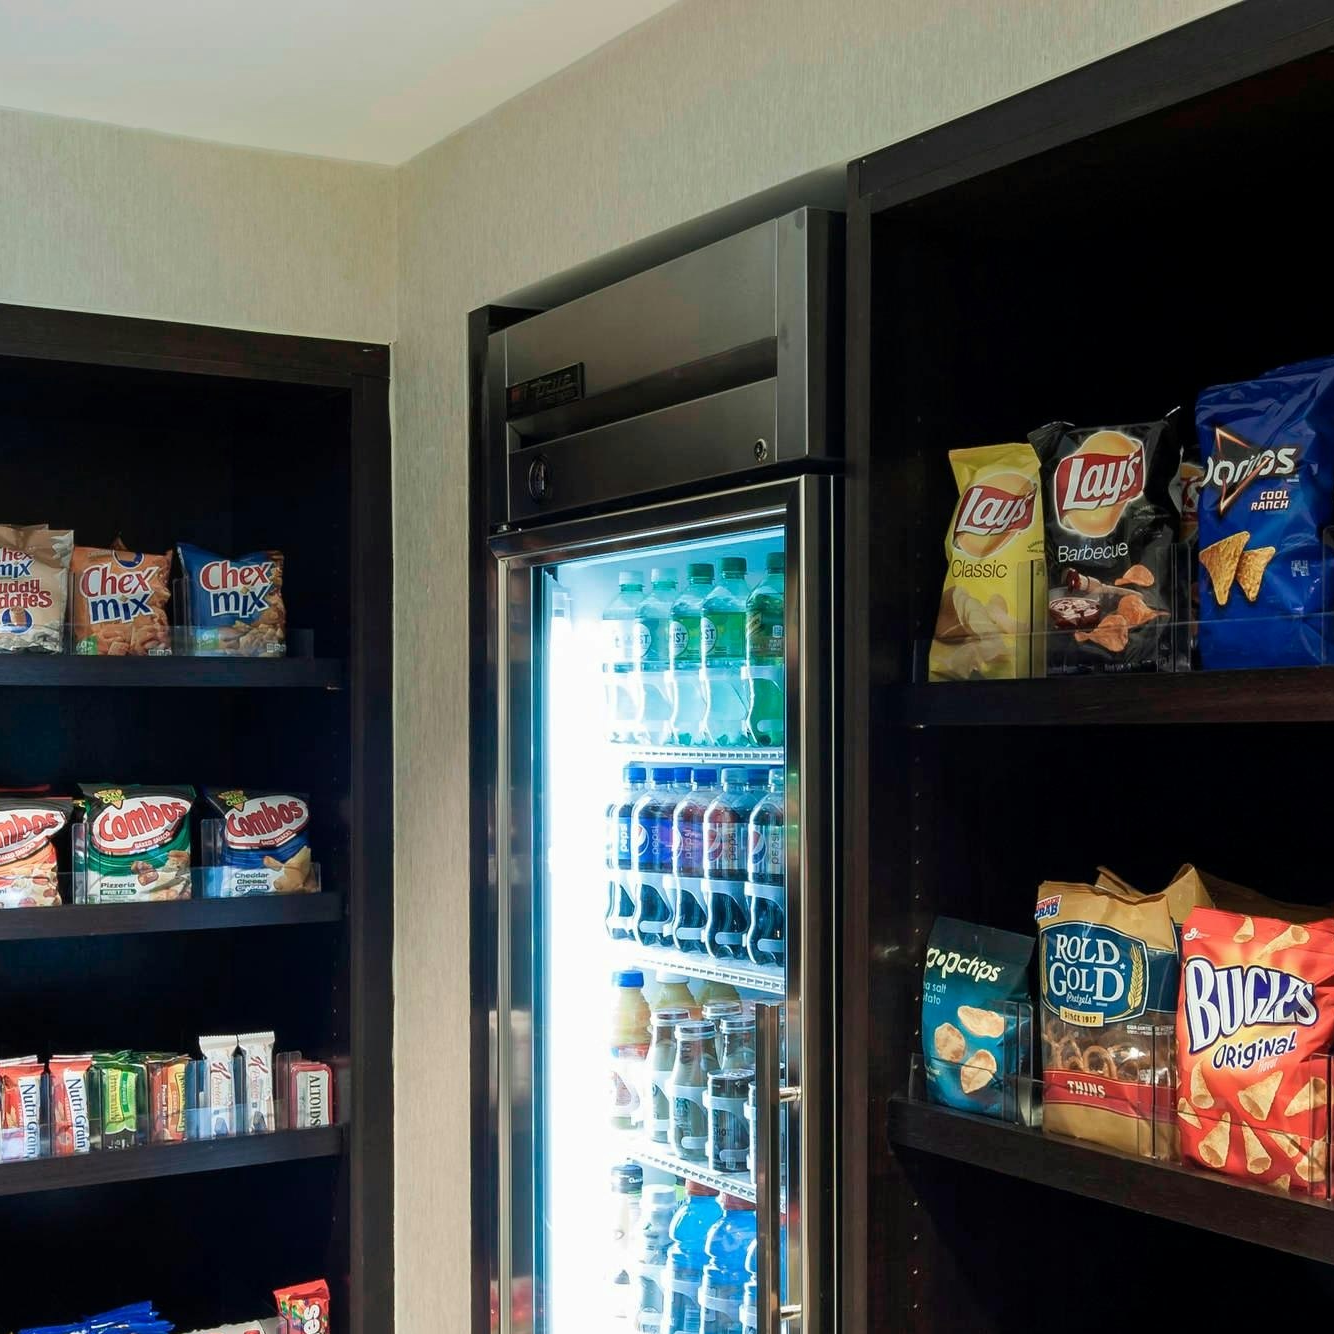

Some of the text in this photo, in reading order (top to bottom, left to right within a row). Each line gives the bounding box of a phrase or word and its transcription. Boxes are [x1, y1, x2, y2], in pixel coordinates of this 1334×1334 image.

[1063, 452, 1140, 510] Lay's
[1260, 490, 1289, 500] COOL
[956, 486, 1037, 536] Lay's
[1250, 500, 1289, 511] RANCH
[1058, 541, 1128, 563] Barbecue
[81, 563, 158, 598] Chex
[201, 561, 273, 590] Chex
[951, 560, 1008, 579] Classic
[673, 632, 687, 643] IST
[98, 801, 188, 842] Combos
[227, 801, 302, 837] Combos
[652, 825, 660, 855] pepsi
[729, 831, 739, 860] pepsi
[771, 833, 779, 865] pepsi
[1055, 934, 1121, 965] ROLD
[932, 982, 946, 994] salt
[1049, 963, 1124, 1002] GOLD
[1066, 992, 1092, 1006] Pretzels
[1185, 958, 1317, 1053] BUGLES
[1064, 1011, 1097, 1024] SINCE 1917
[1067, 1080, 1106, 1098] THINS
